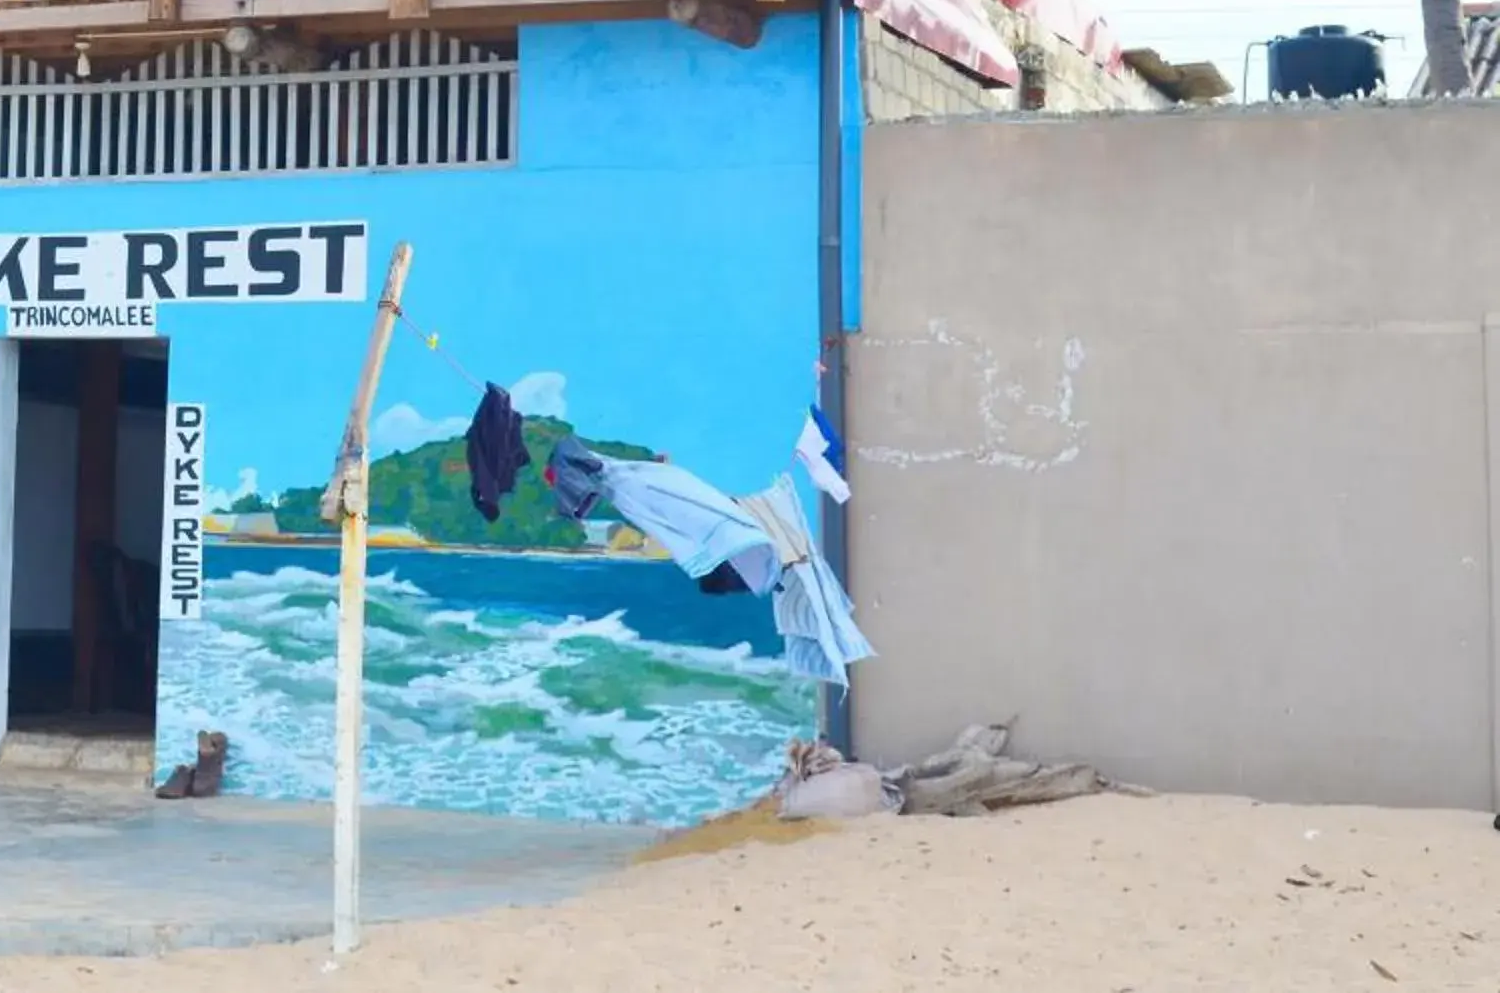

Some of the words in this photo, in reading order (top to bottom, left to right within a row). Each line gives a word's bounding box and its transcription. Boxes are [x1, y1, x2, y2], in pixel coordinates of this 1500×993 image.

[124, 225, 365, 297] REST
[11, 306, 154, 328] TRINCOMALEE
[173, 407, 201, 506] DYKE
[172, 518, 199, 616] REST
